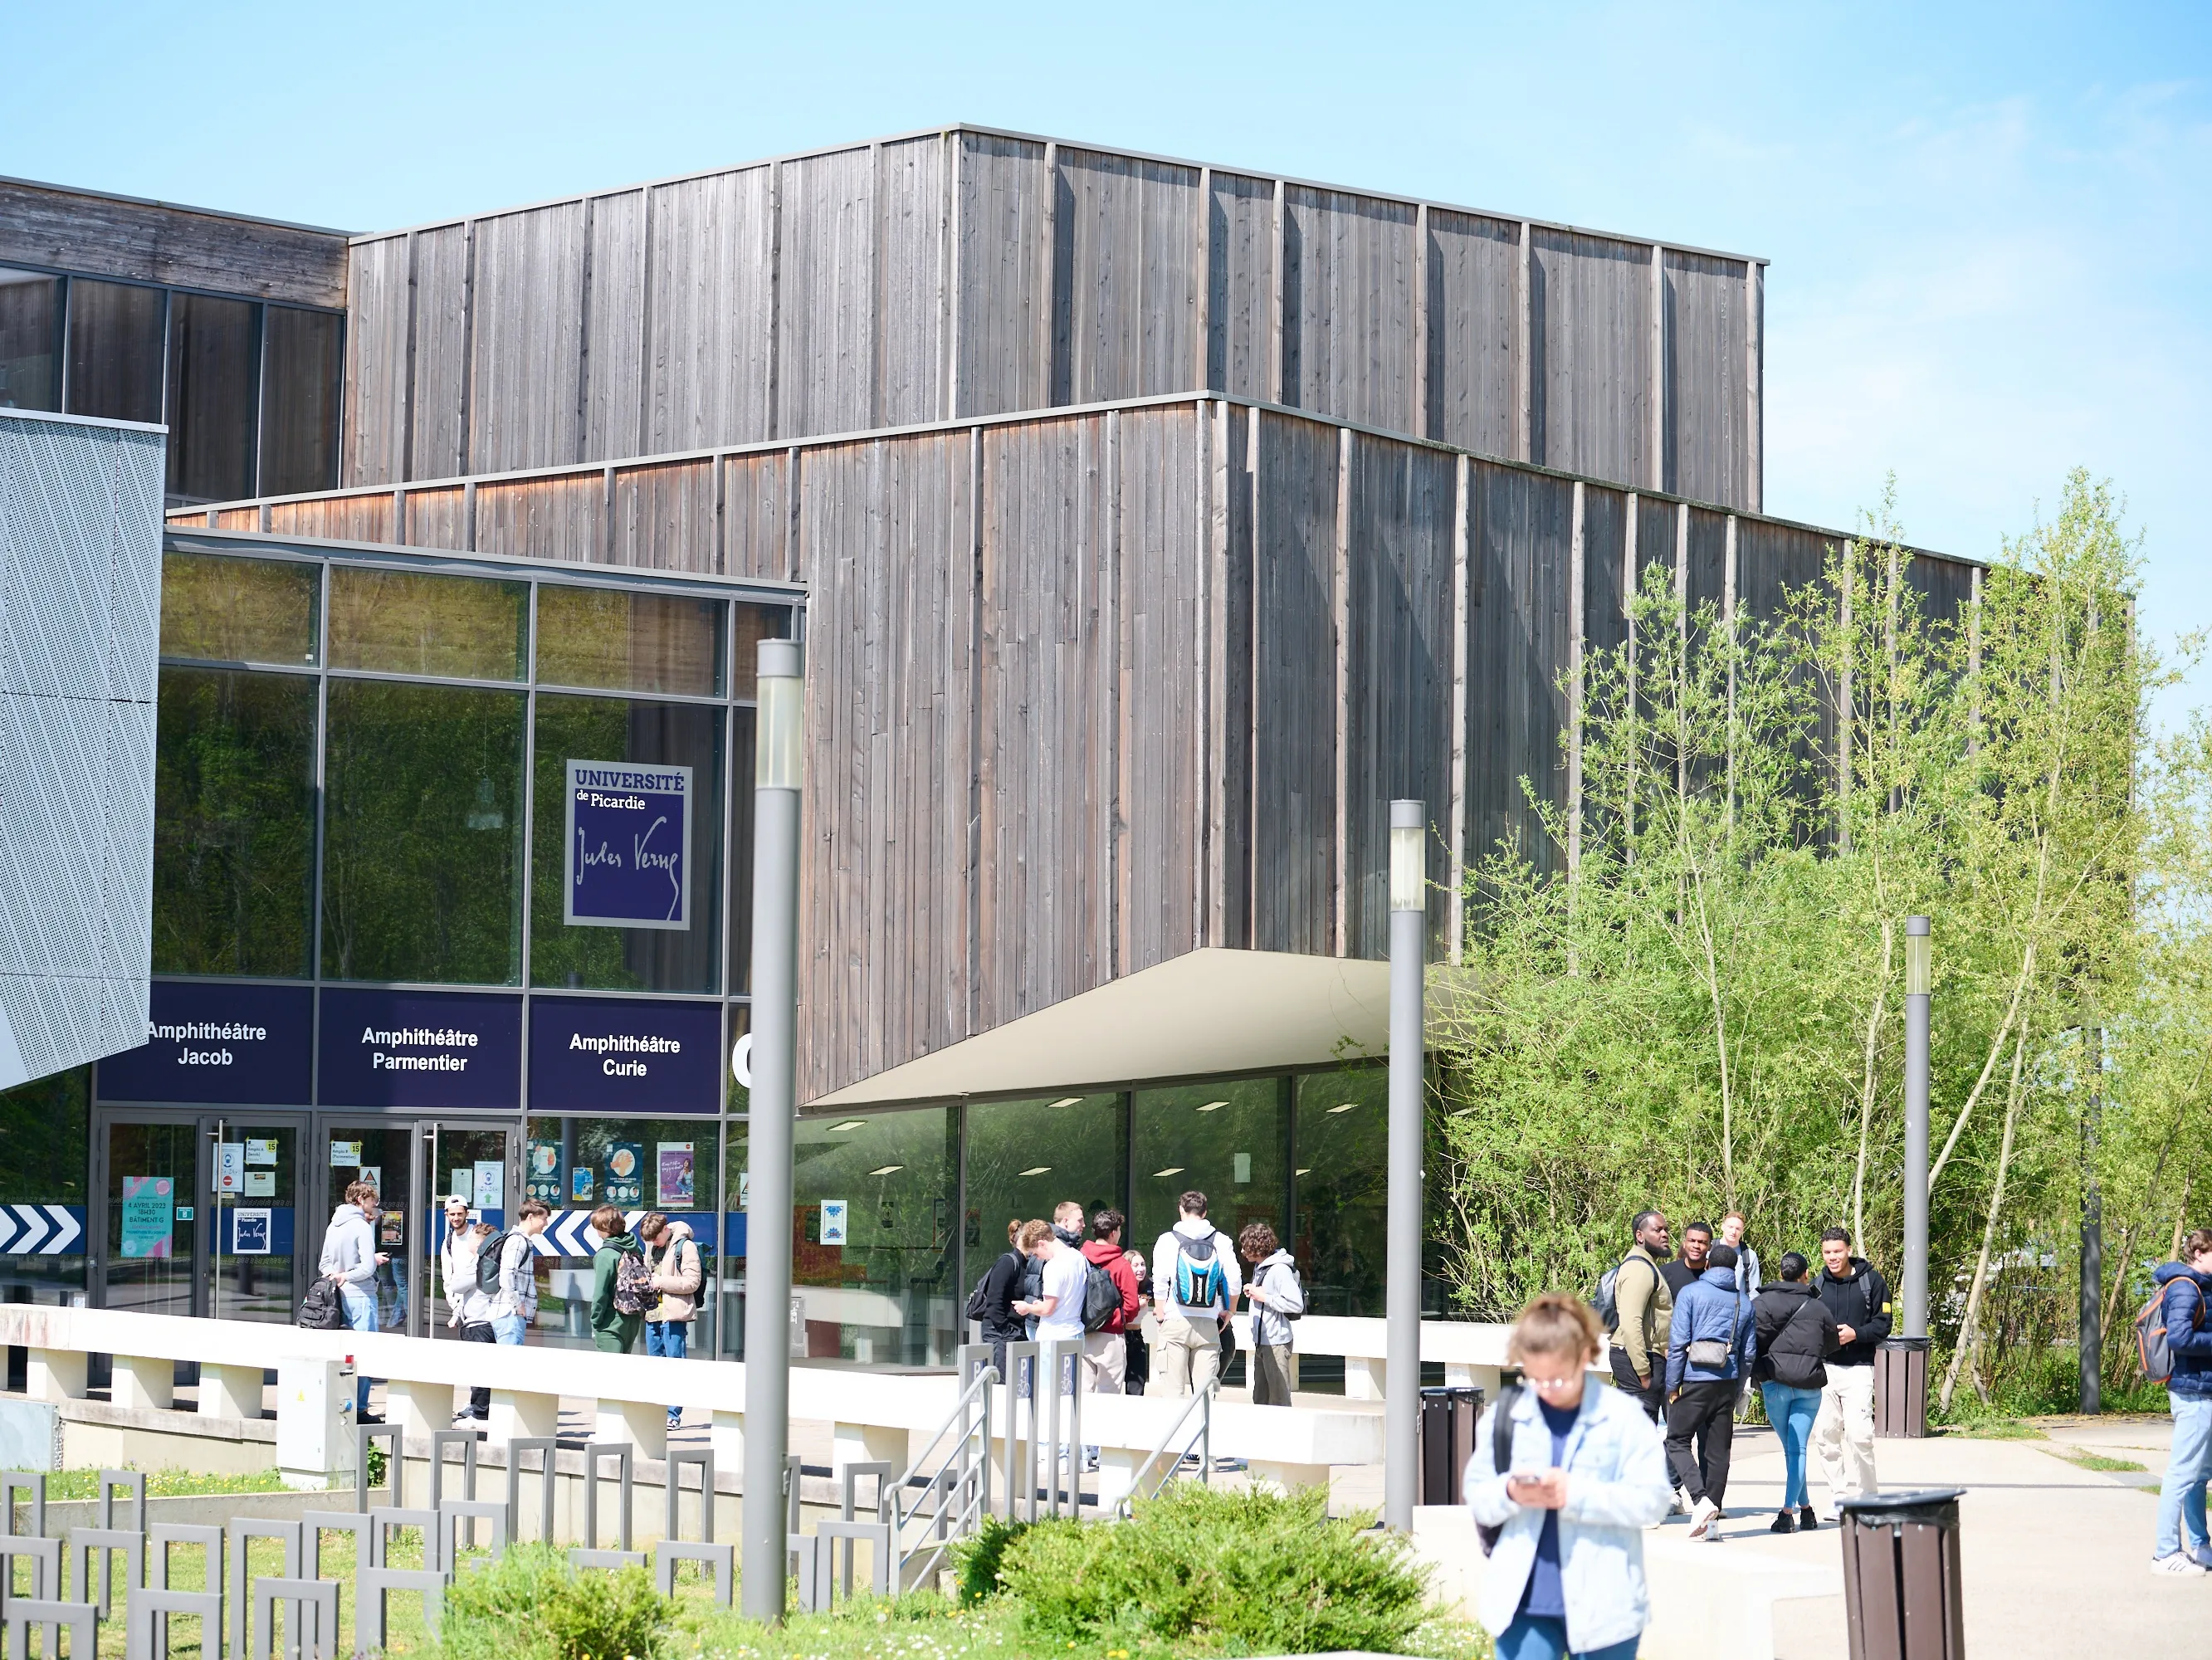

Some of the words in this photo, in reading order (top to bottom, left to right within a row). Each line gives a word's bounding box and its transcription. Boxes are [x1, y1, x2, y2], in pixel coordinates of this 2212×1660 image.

[574, 769, 685, 791] UNIVERSITÉ
[576, 789, 588, 801] de
[590, 793, 646, 810] Picardie
[576, 827, 622, 886] Jules
[634, 816, 680, 921] Verne
[148, 1021, 266, 1043] Amphithéâtre
[361, 1027, 479, 1049] Amphithéâtre
[569, 1033, 681, 1055] Amphithéâtre
[178, 1047, 233, 1066] Jacob
[373, 1052, 468, 1072] Parmentier
[603, 1058, 647, 1077] Curie
[974, 1361, 980, 1380] P
[1020, 1358, 1028, 1377] P
[1063, 1355, 1071, 1374] P
